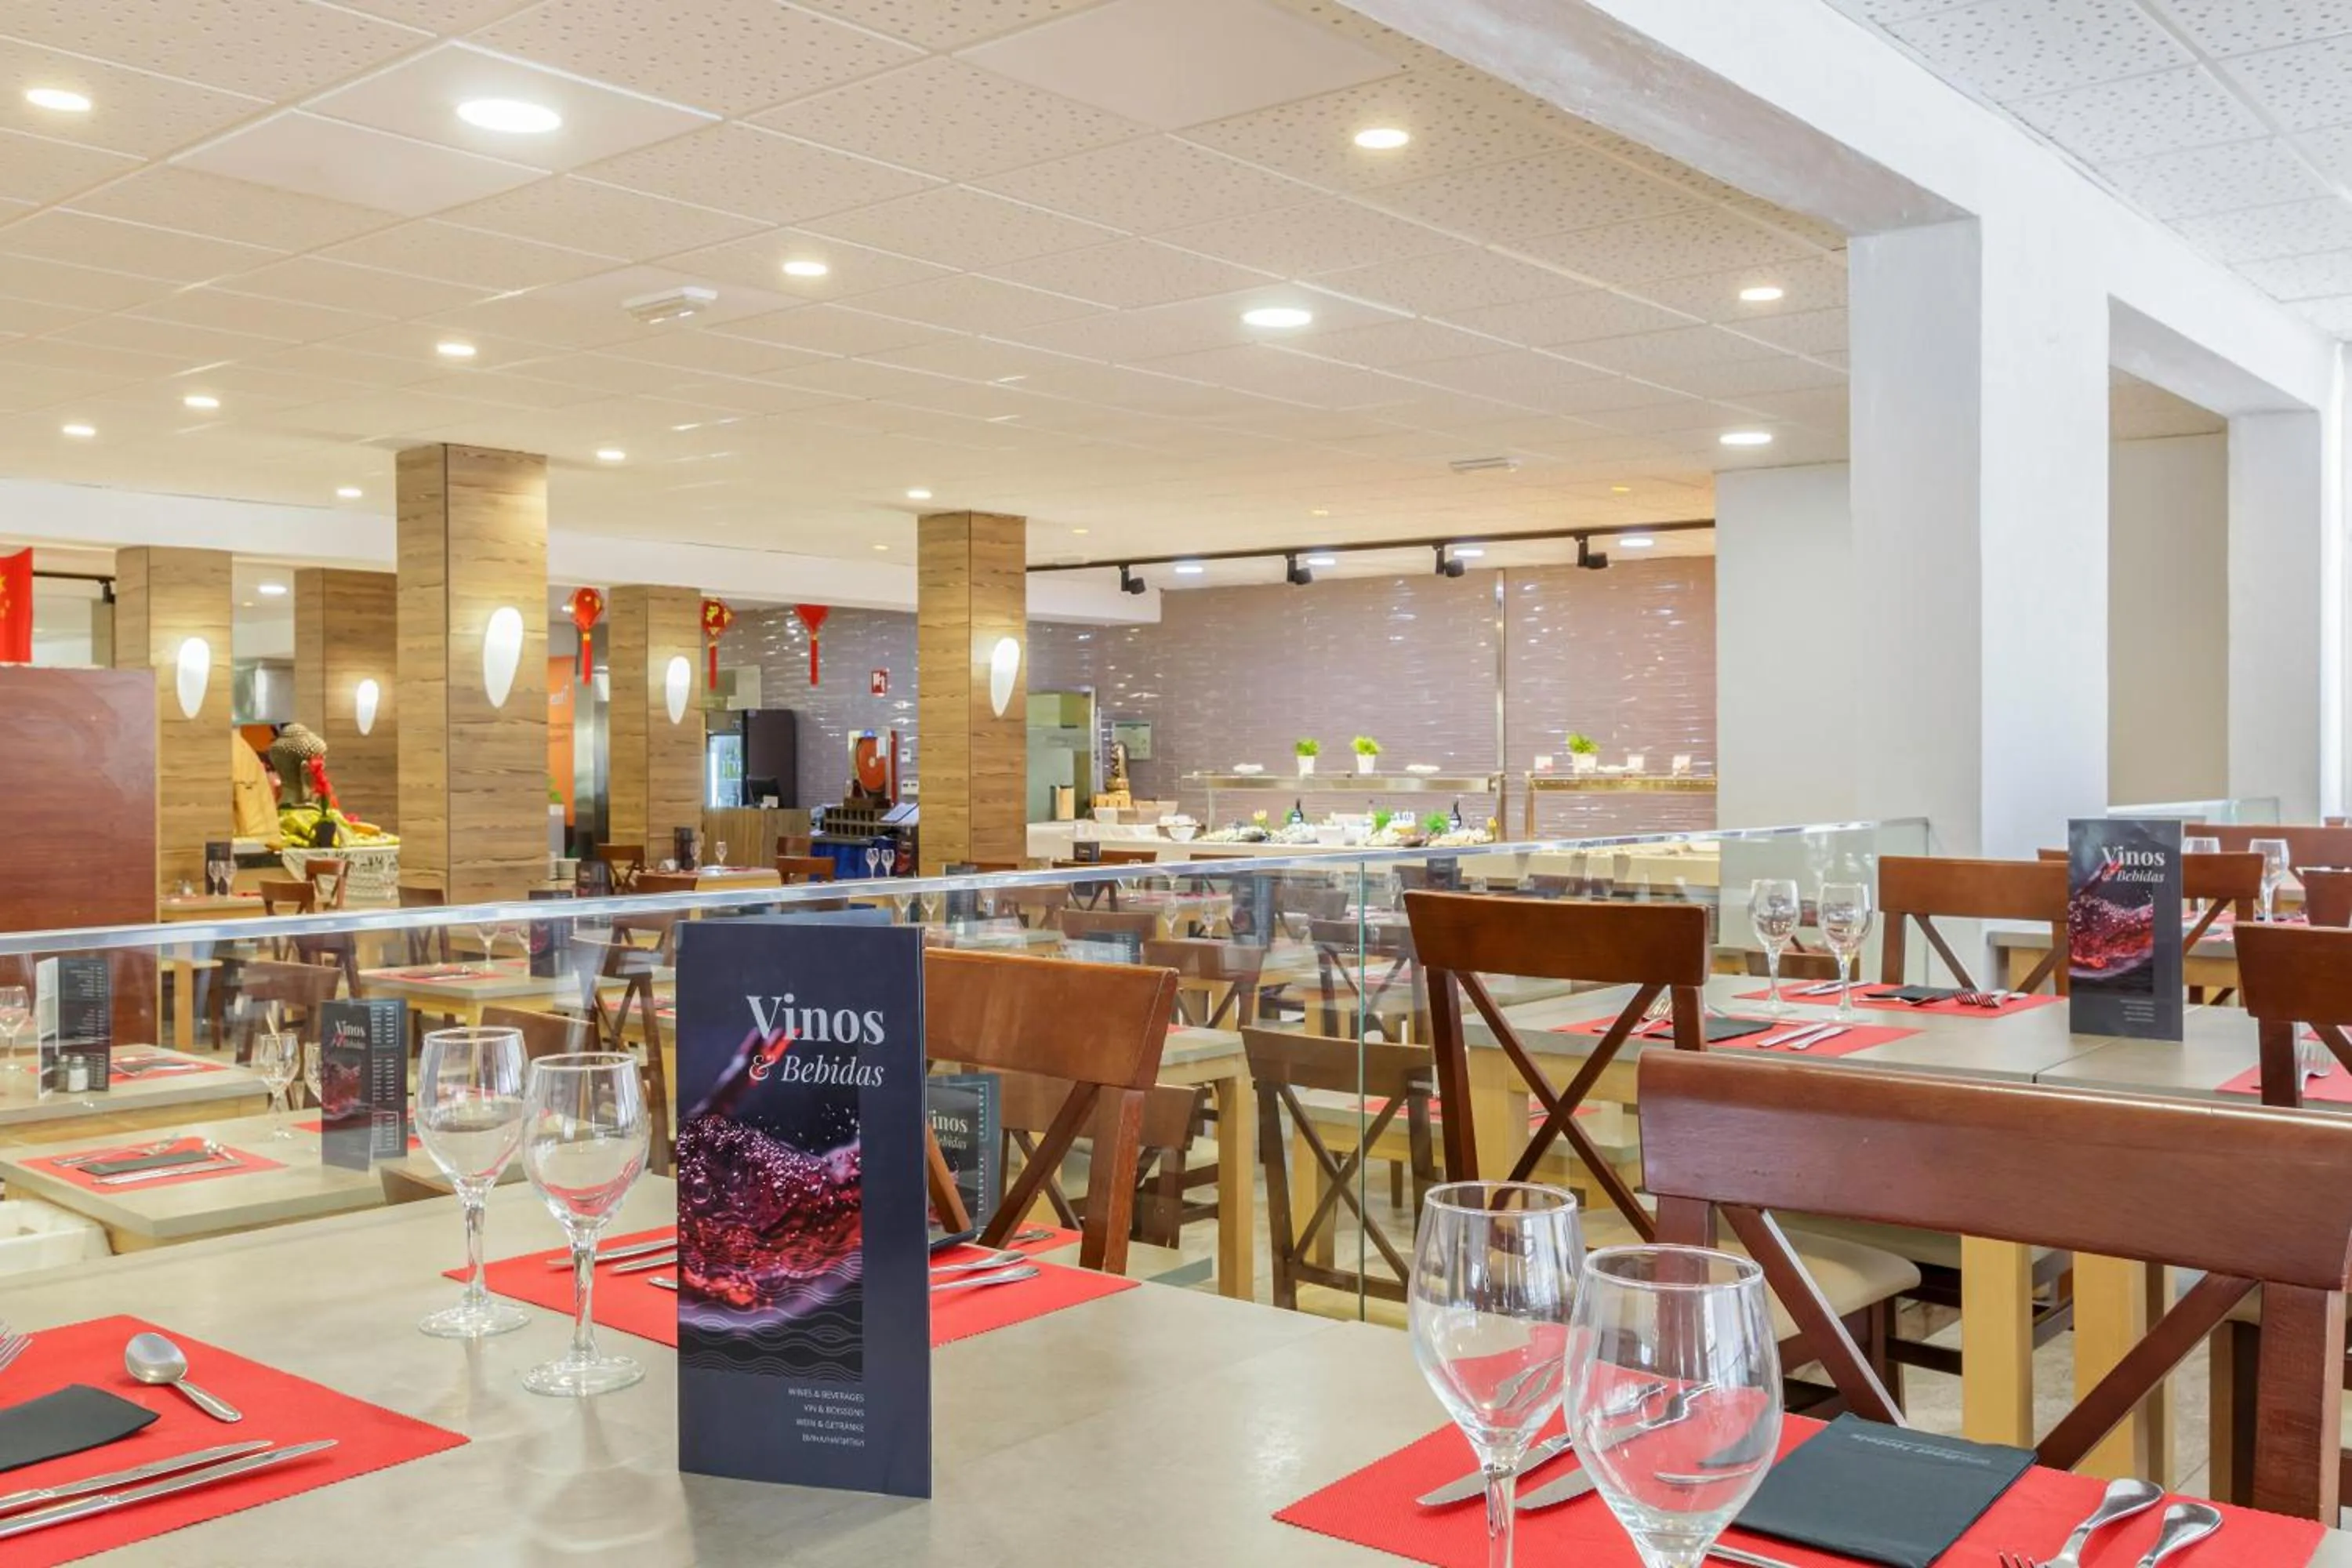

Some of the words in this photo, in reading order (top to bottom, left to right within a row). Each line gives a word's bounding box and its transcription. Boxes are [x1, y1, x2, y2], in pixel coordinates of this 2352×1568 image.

[2101, 845, 2165, 866] Vinos
[2117, 869, 2165, 883] Bebidas
[746, 993, 885, 1045] Vinos
[749, 1054, 776, 1080] &
[781, 1054, 884, 1087] Bebidas
[821, 1391, 865, 1403] BEVERAGES
